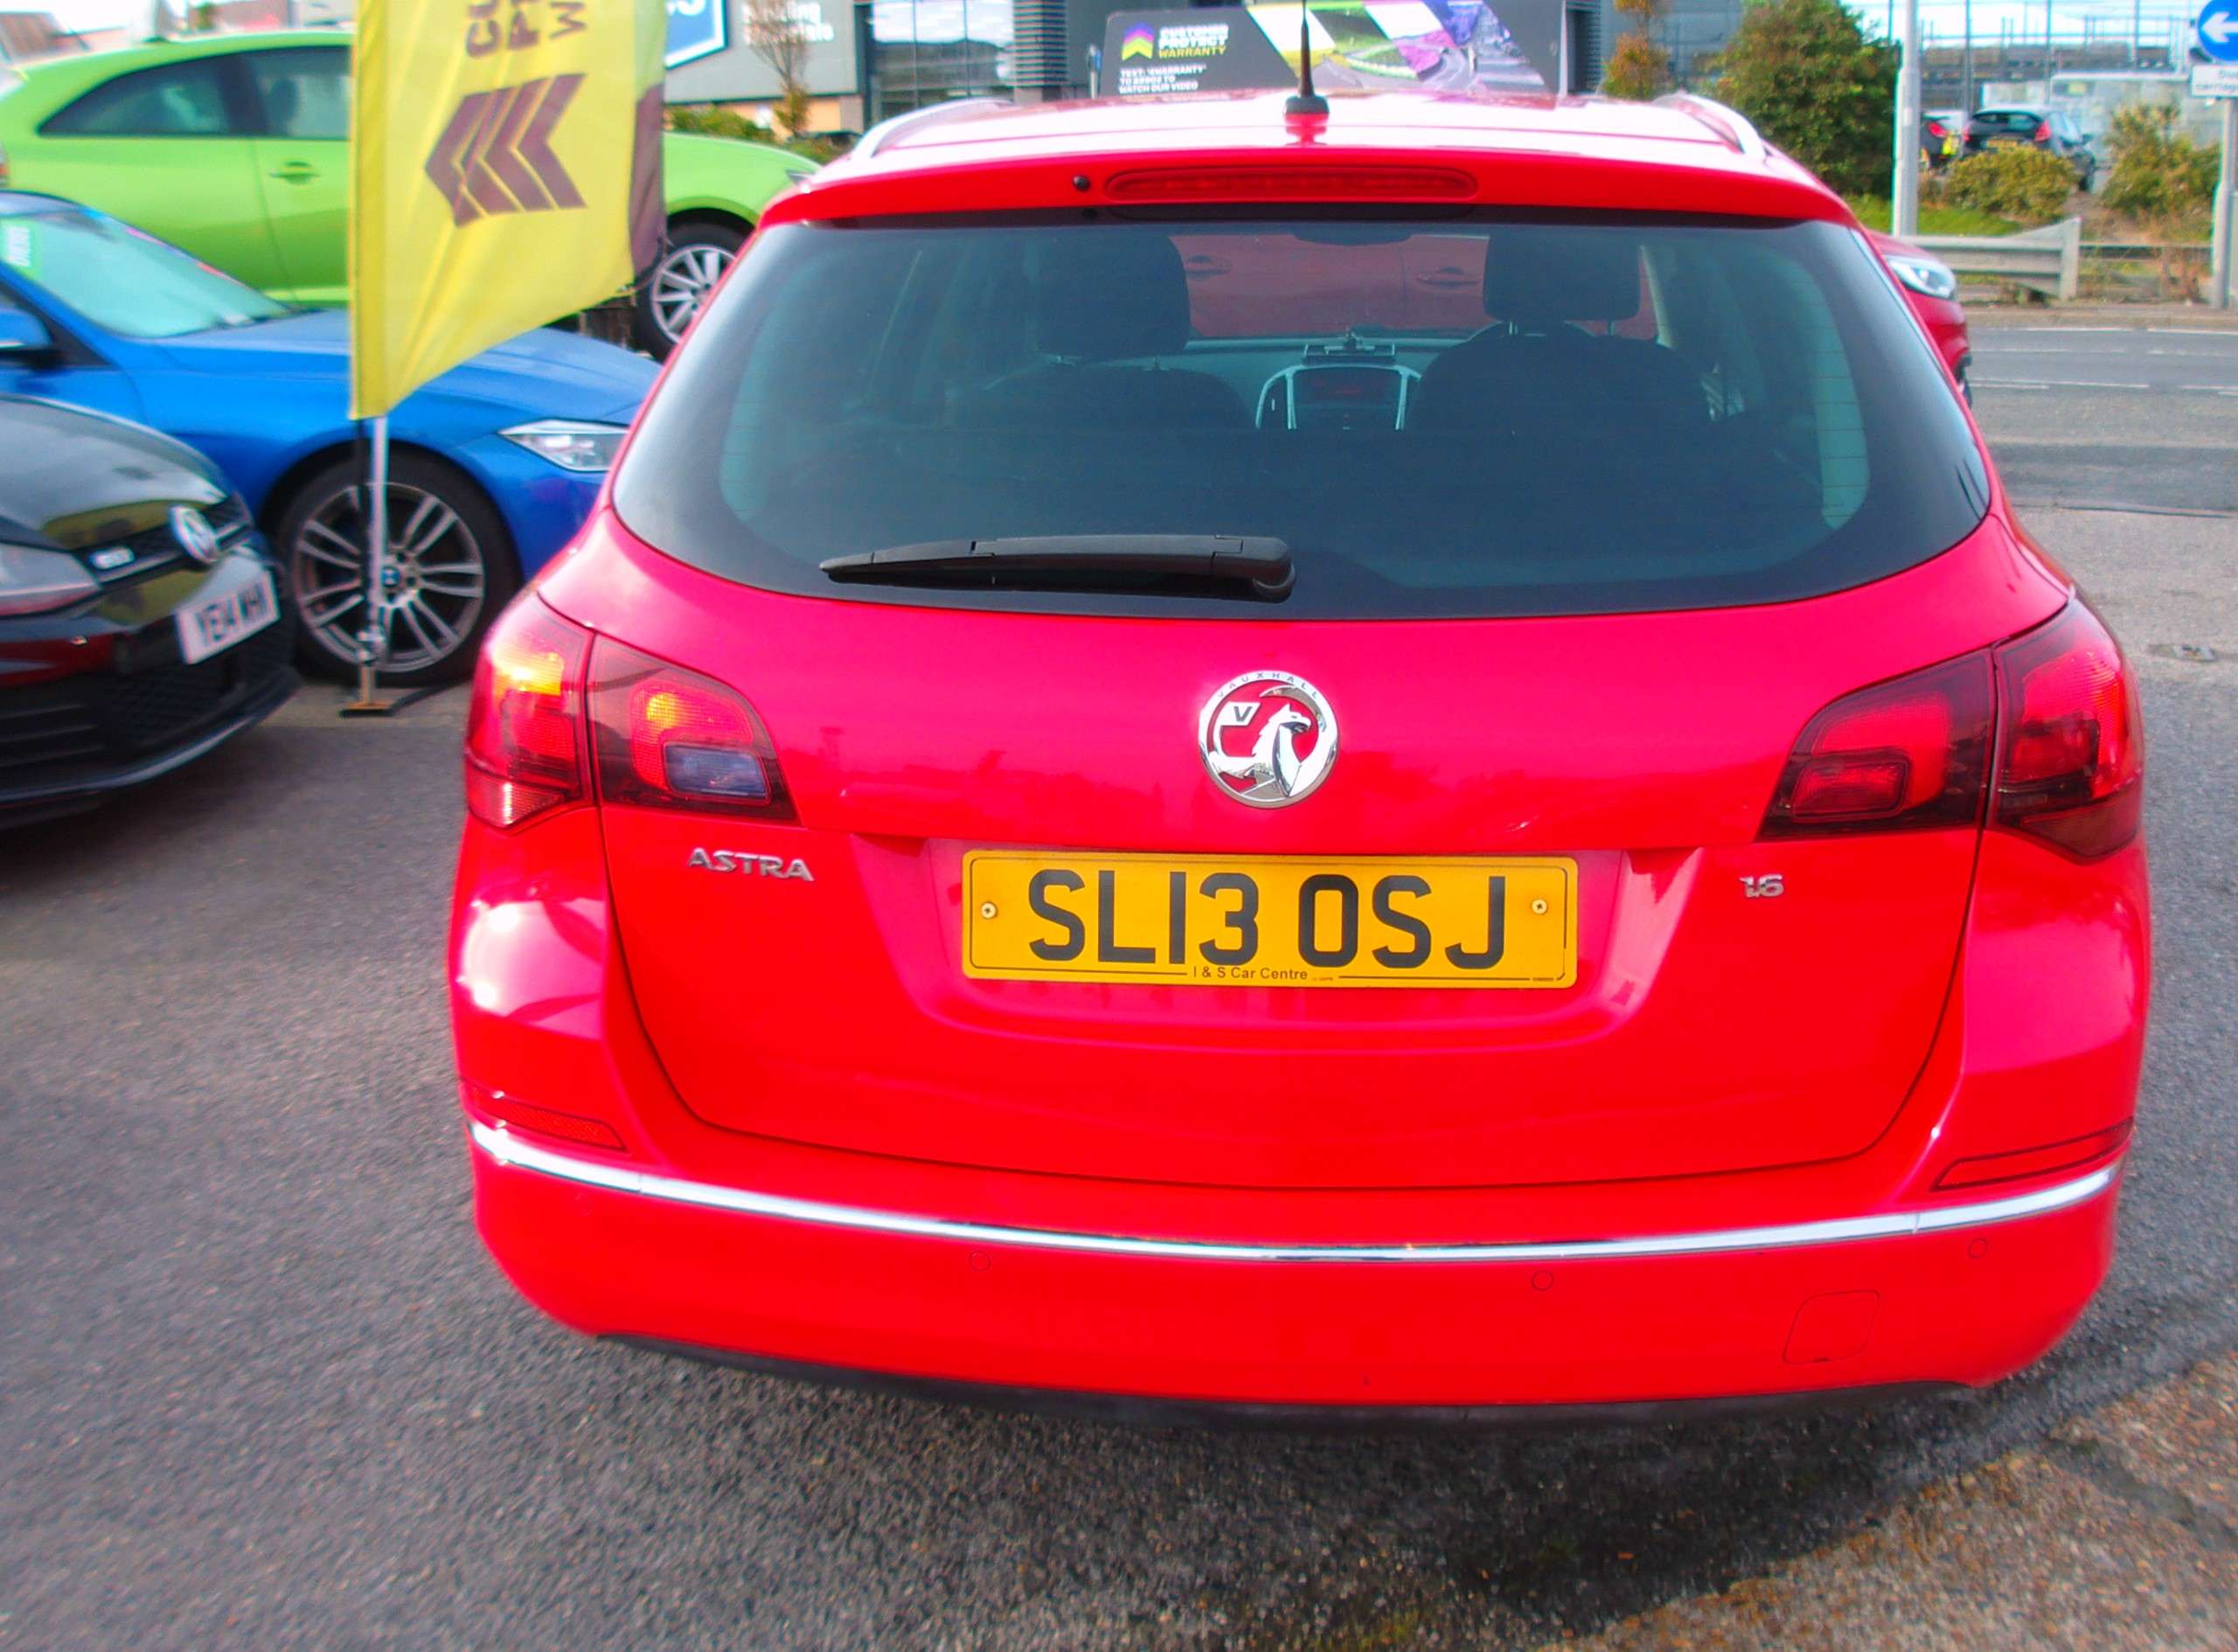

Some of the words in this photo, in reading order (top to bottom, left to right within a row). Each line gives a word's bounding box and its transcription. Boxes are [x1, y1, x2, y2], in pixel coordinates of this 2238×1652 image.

[1158, 35, 1228, 49] PROTECT
[1158, 45, 1227, 59] WARRANTY
[1119, 84, 1150, 94] WATCH
[1151, 83, 1170, 92] OUR
[1171, 80, 1199, 91] VIDEO
[1217, 671, 1318, 699] VAUXHALL
[1234, 705, 1253, 722] V
[687, 847, 815, 881] ASTRA
[1027, 868, 1260, 967] SL13
[1297, 873, 1506, 969] OSJ
[1201, 966, 1212, 978] &
[1216, 966, 1227, 979] S
[1230, 966, 1256, 980] Car
[1260, 967, 1309, 980] Centre
